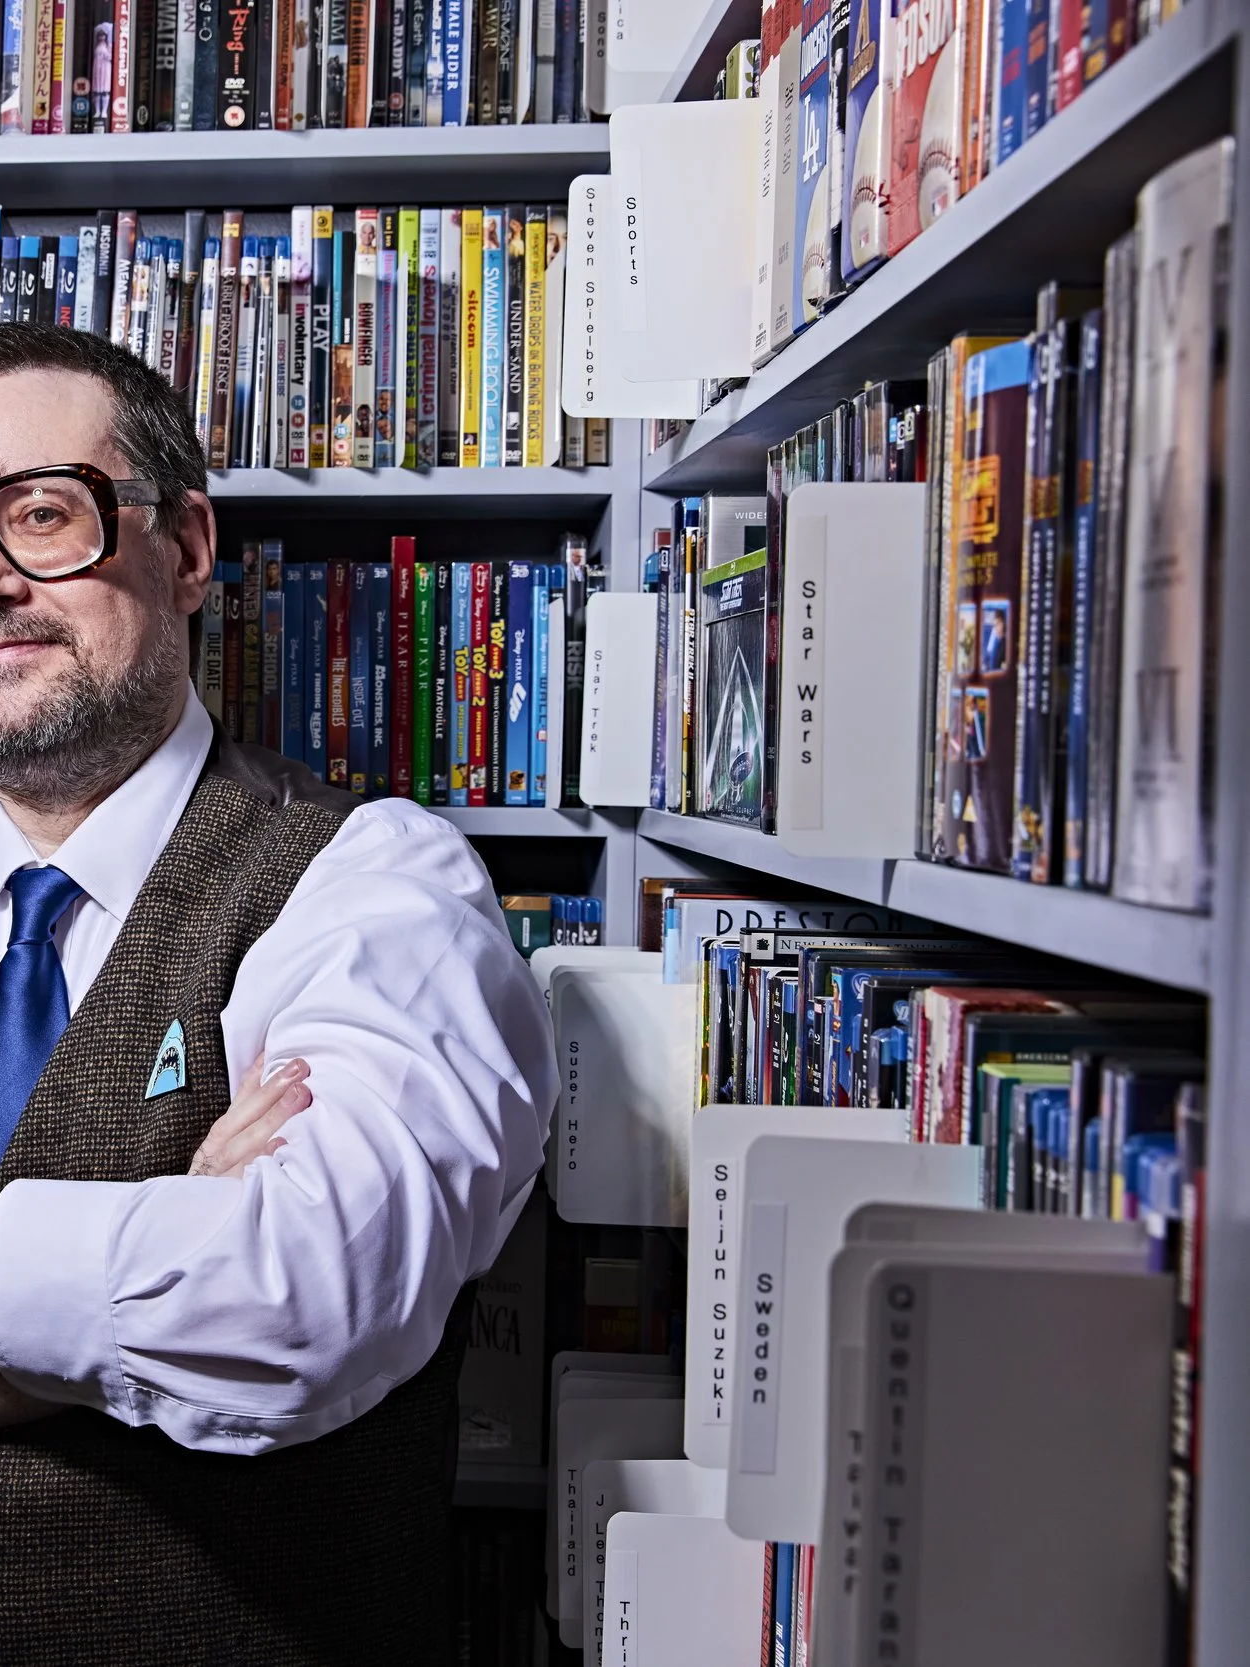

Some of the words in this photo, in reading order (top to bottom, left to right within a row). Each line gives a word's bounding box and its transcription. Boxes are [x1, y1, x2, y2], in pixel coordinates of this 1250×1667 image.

[225, 8, 249, 51] Ring
[98, 225, 111, 276] INSOMNIA
[585, 187, 597, 267] Steven
[625, 195, 639, 286] Sports
[219, 266, 236, 353] RABBIT-PROOF
[420, 265, 436, 327] lovers
[468, 289, 480, 348] sitcom
[485, 267, 499, 358] SWIMMING
[162, 330, 175, 370] DEAD
[291, 303, 309, 386] involuntary
[313, 304, 330, 352] PLAY
[357, 303, 374, 366] BOWFINGER
[510, 299, 521, 349] UNDER
[584, 281, 597, 401] Spielberg
[217, 357, 231, 395] FENCE
[421, 334, 436, 416] criminal
[485, 364, 499, 407] POOL
[509, 355, 521, 393] SAND
[207, 632, 221, 657] DUE
[398, 612, 409, 669] PIXAR
[513, 629, 525, 654] Disney
[800, 579, 817, 660] Star
[206, 659, 220, 691] DATE
[264, 632, 278, 695] SCHOOL
[332, 657, 347, 672] THE
[514, 658, 522, 681] PIXAR
[567, 640, 583, 690] RISK
[593, 649, 603, 698] Star
[314, 672, 322, 709] FINDING
[332, 674, 347, 727] INCREDIBLES
[351, 676, 366, 707] INSIDE
[509, 683, 527, 723] UP
[310, 711, 322, 749] NEMO
[351, 709, 365, 729] OUT
[588, 706, 601, 754] Trek
[797, 682, 818, 765] Wars
[568, 1040, 579, 1108] Super
[567, 1118, 578, 1172] Hero
[713, 1165, 729, 1280] Seijun
[711, 1303, 727, 1421] Suzuki
[753, 1272, 775, 1405] Sweden
[883, 1283, 916, 1487] Quentin
[567, 1469, 577, 1576] Thailand
[596, 1494, 605, 1507] J
[595, 1522, 605, 1564] Lee
[619, 1601, 630, 1667] Thri
